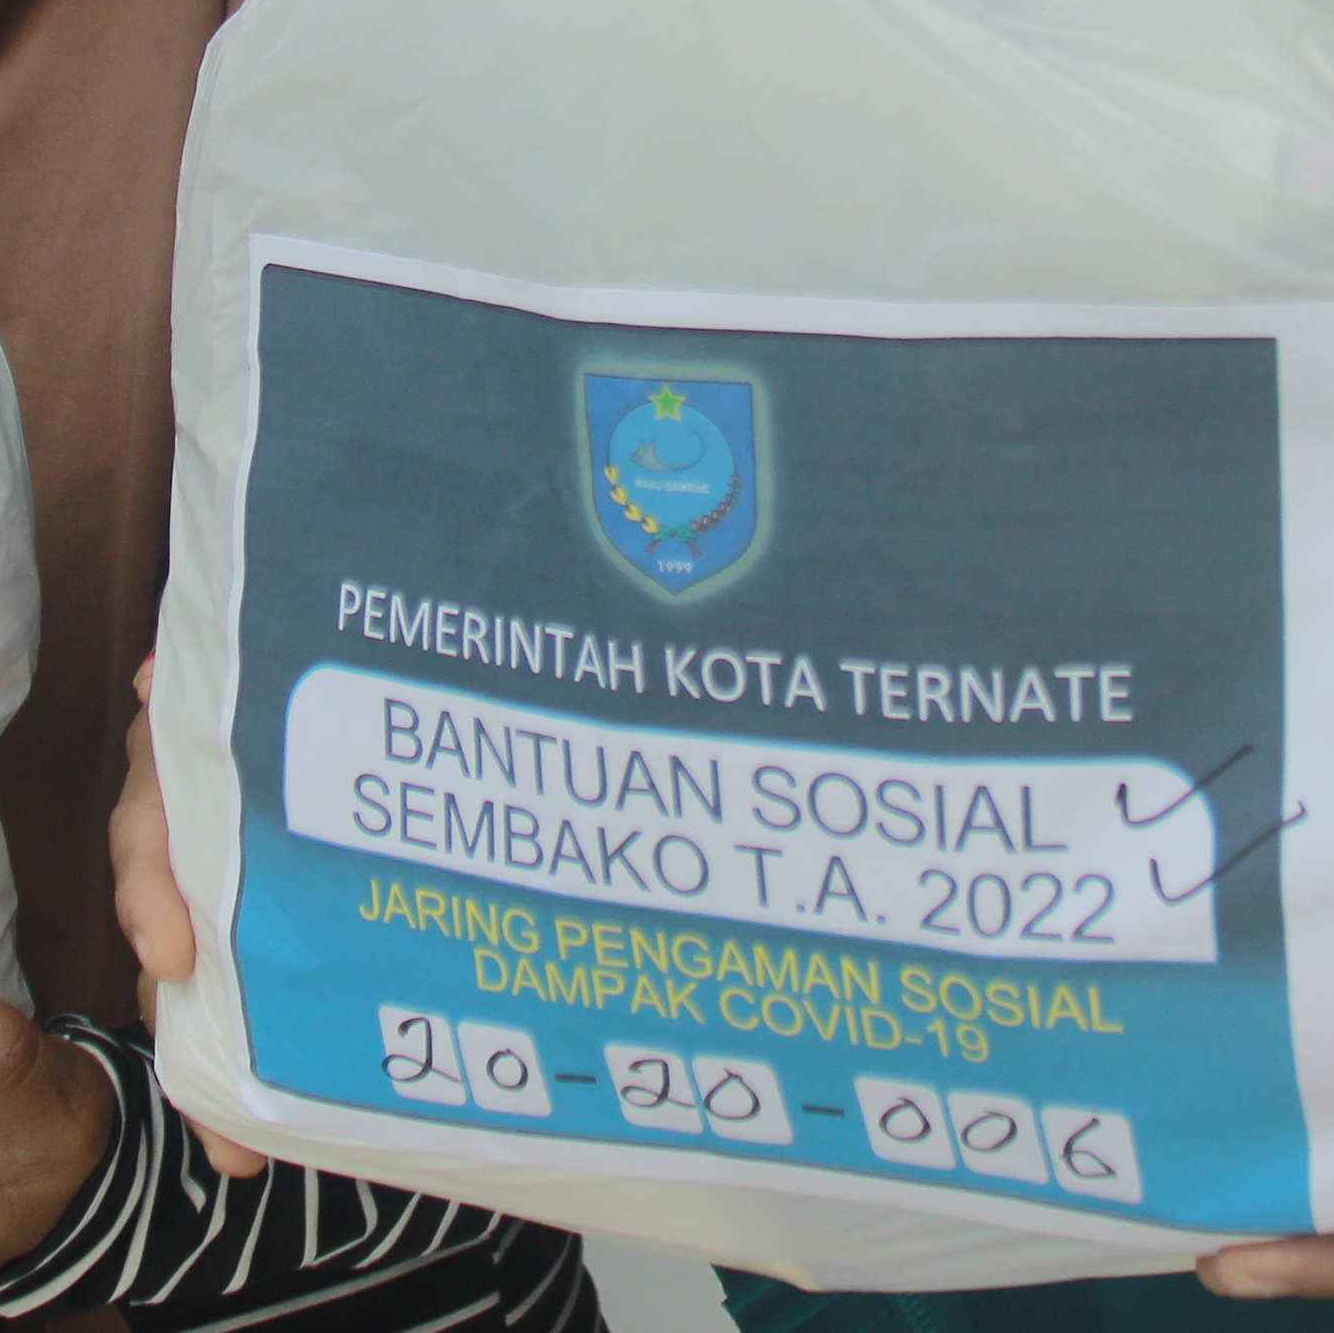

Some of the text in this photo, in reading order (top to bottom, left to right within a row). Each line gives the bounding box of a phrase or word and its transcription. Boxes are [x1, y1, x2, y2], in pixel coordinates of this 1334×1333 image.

[656, 560, 693, 574] 1999
[338, 582, 1133, 724] PEMERINTAH KOTA TERNATE
[383, 697, 1067, 855] BANTUAN SOSIAL
[352, 773, 710, 898] SEMBAKO
[918, 869, 1115, 944] 2022
[358, 880, 1124, 1033] JARING PENGAMAN SOSIAL
[474, 948, 989, 1063] DAMPAK COVID-19
